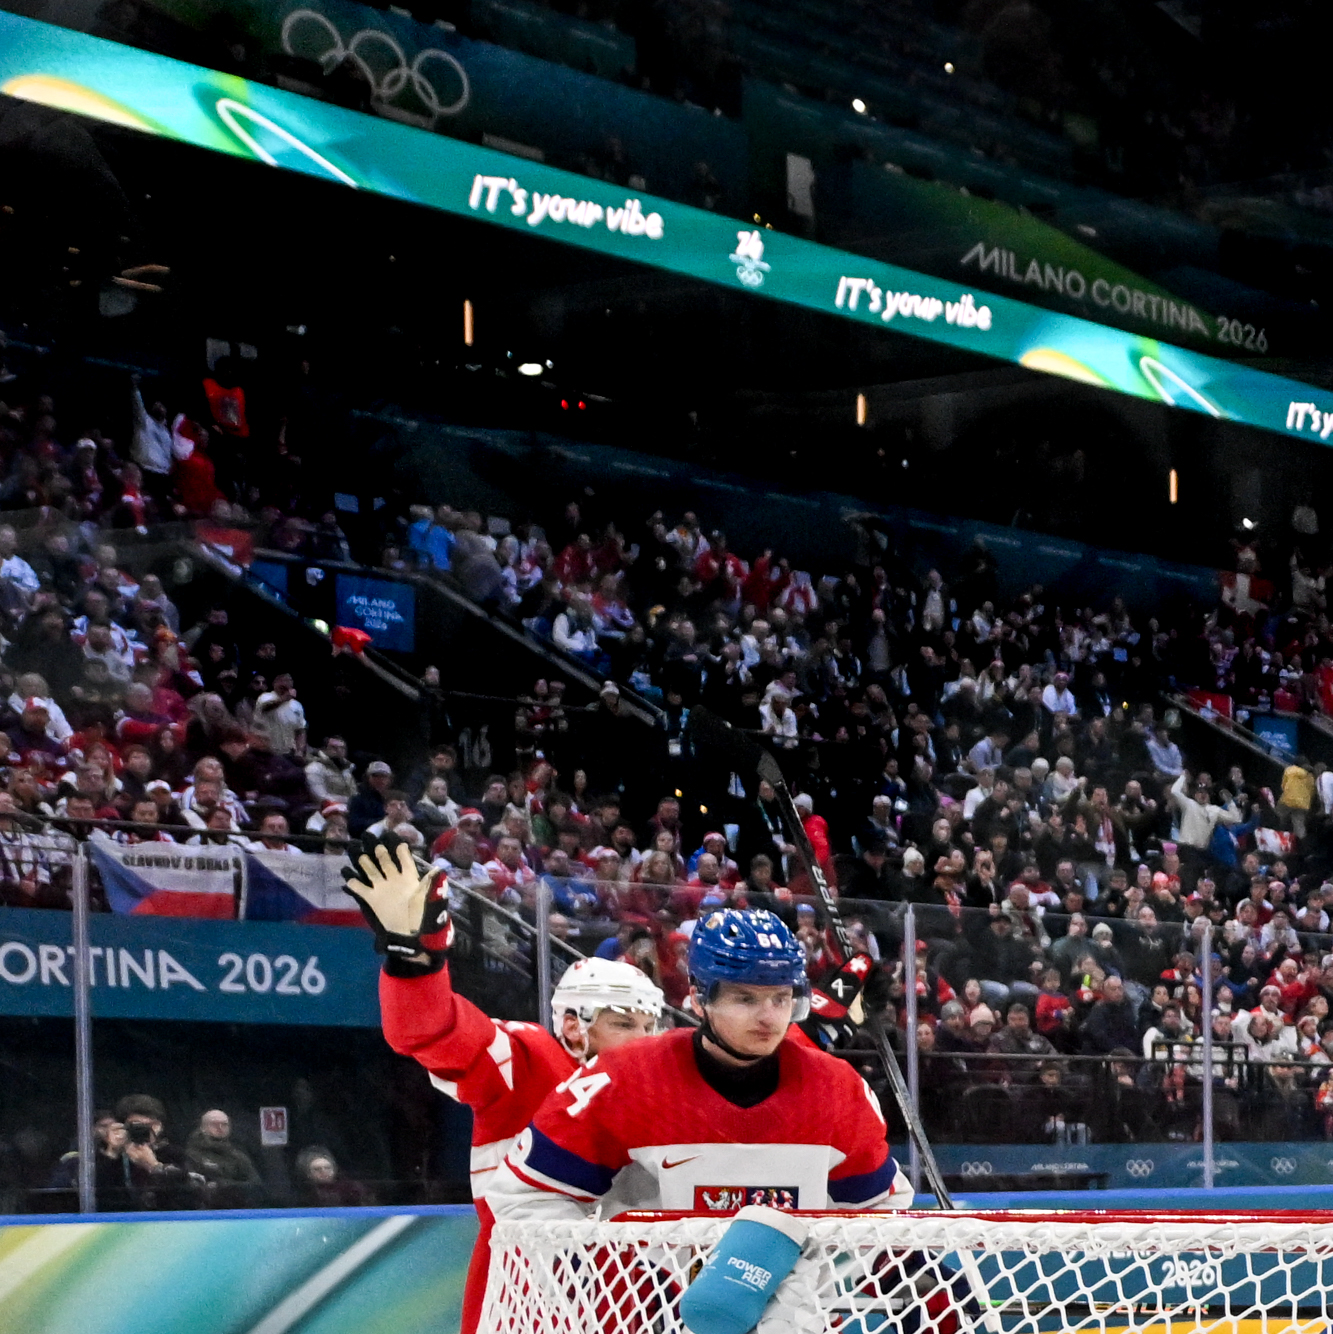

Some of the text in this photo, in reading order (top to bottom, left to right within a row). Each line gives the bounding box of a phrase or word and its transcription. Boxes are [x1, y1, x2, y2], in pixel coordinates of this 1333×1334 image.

[468, 174, 664, 240] IT's your vibe
[835, 276, 992, 330] IT's your vibe
[960, 241, 1269, 354] MILANO CORTINA 2026
[1286, 401, 1321, 432] IT's
[346, 595, 396, 610] MILANO
[757, 933, 782, 949] 64
[218, 953, 326, 995] 2026
[727, 1257, 772, 1281] POWER
[741, 1271, 768, 1290] ADE
